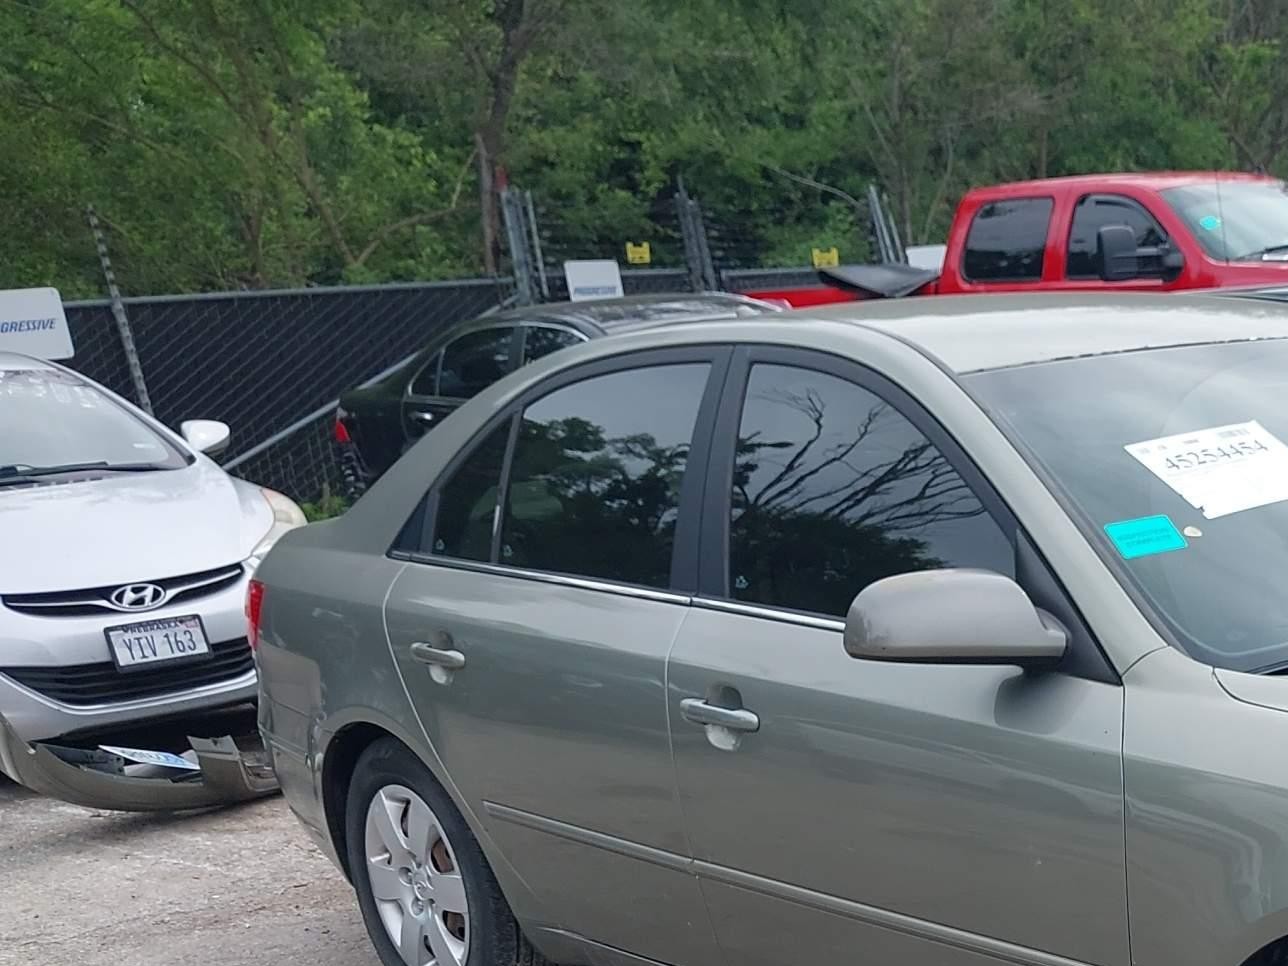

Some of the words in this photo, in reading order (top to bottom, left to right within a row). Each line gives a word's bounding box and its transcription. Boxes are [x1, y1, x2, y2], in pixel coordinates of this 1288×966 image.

[1165, 440, 1269, 470] 45254454
[123, 635, 158, 661] YIV
[163, 630, 197, 655] 163
